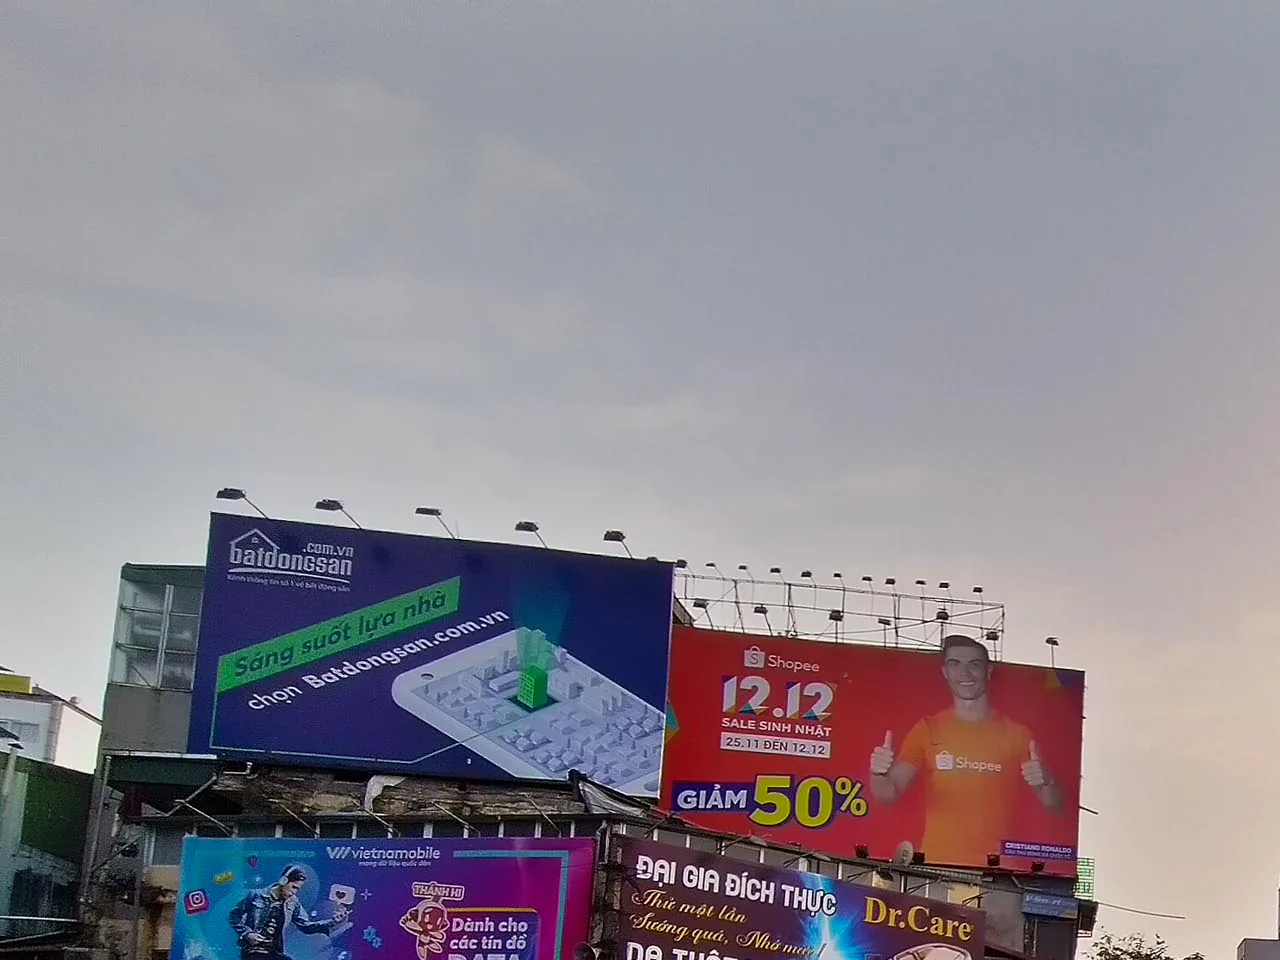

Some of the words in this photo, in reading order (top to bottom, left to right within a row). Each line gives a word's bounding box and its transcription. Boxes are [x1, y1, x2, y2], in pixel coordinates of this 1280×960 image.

[303, 542, 354, 557] .com.vn
[234, 645, 295, 677] Sáng
[301, 625, 351, 655] suốt
[358, 610, 396, 638] lựa
[403, 590, 447, 619] nhà
[248, 684, 304, 711] chọn
[302, 609, 511, 689] Batdongsan.com.vn
[768, 655, 820, 672] Shopee
[722, 675, 834, 720] 12.12
[722, 718, 756, 729] SALE
[759, 721, 792, 733] SINH
[795, 725, 832, 738] NHẬT
[726, 737, 759, 748] 25.11
[764, 740, 788, 751] ĐẾN
[793, 743, 825, 754] 12.12
[956, 756, 1001, 772] Shopee
[677, 784, 747, 809] GIẢM
[750, 775, 867, 827] 50%
[352, 847, 440, 859] vietnamobile
[450, 887, 462, 897] HI
[636, 855, 677, 888] ĐẠI
[683, 865, 719, 893] GIA
[725, 872, 775, 904] ĐÍCH
[782, 884, 837, 916] THỰC
[679, 901, 714, 918] một
[451, 917, 494, 932] Dành
[498, 917, 528, 932] cho
[864, 896, 973, 941] Dr.Care
[450, 935, 477, 949] các
[481, 935, 502, 949] tín
[506, 933, 527, 949] đồ
